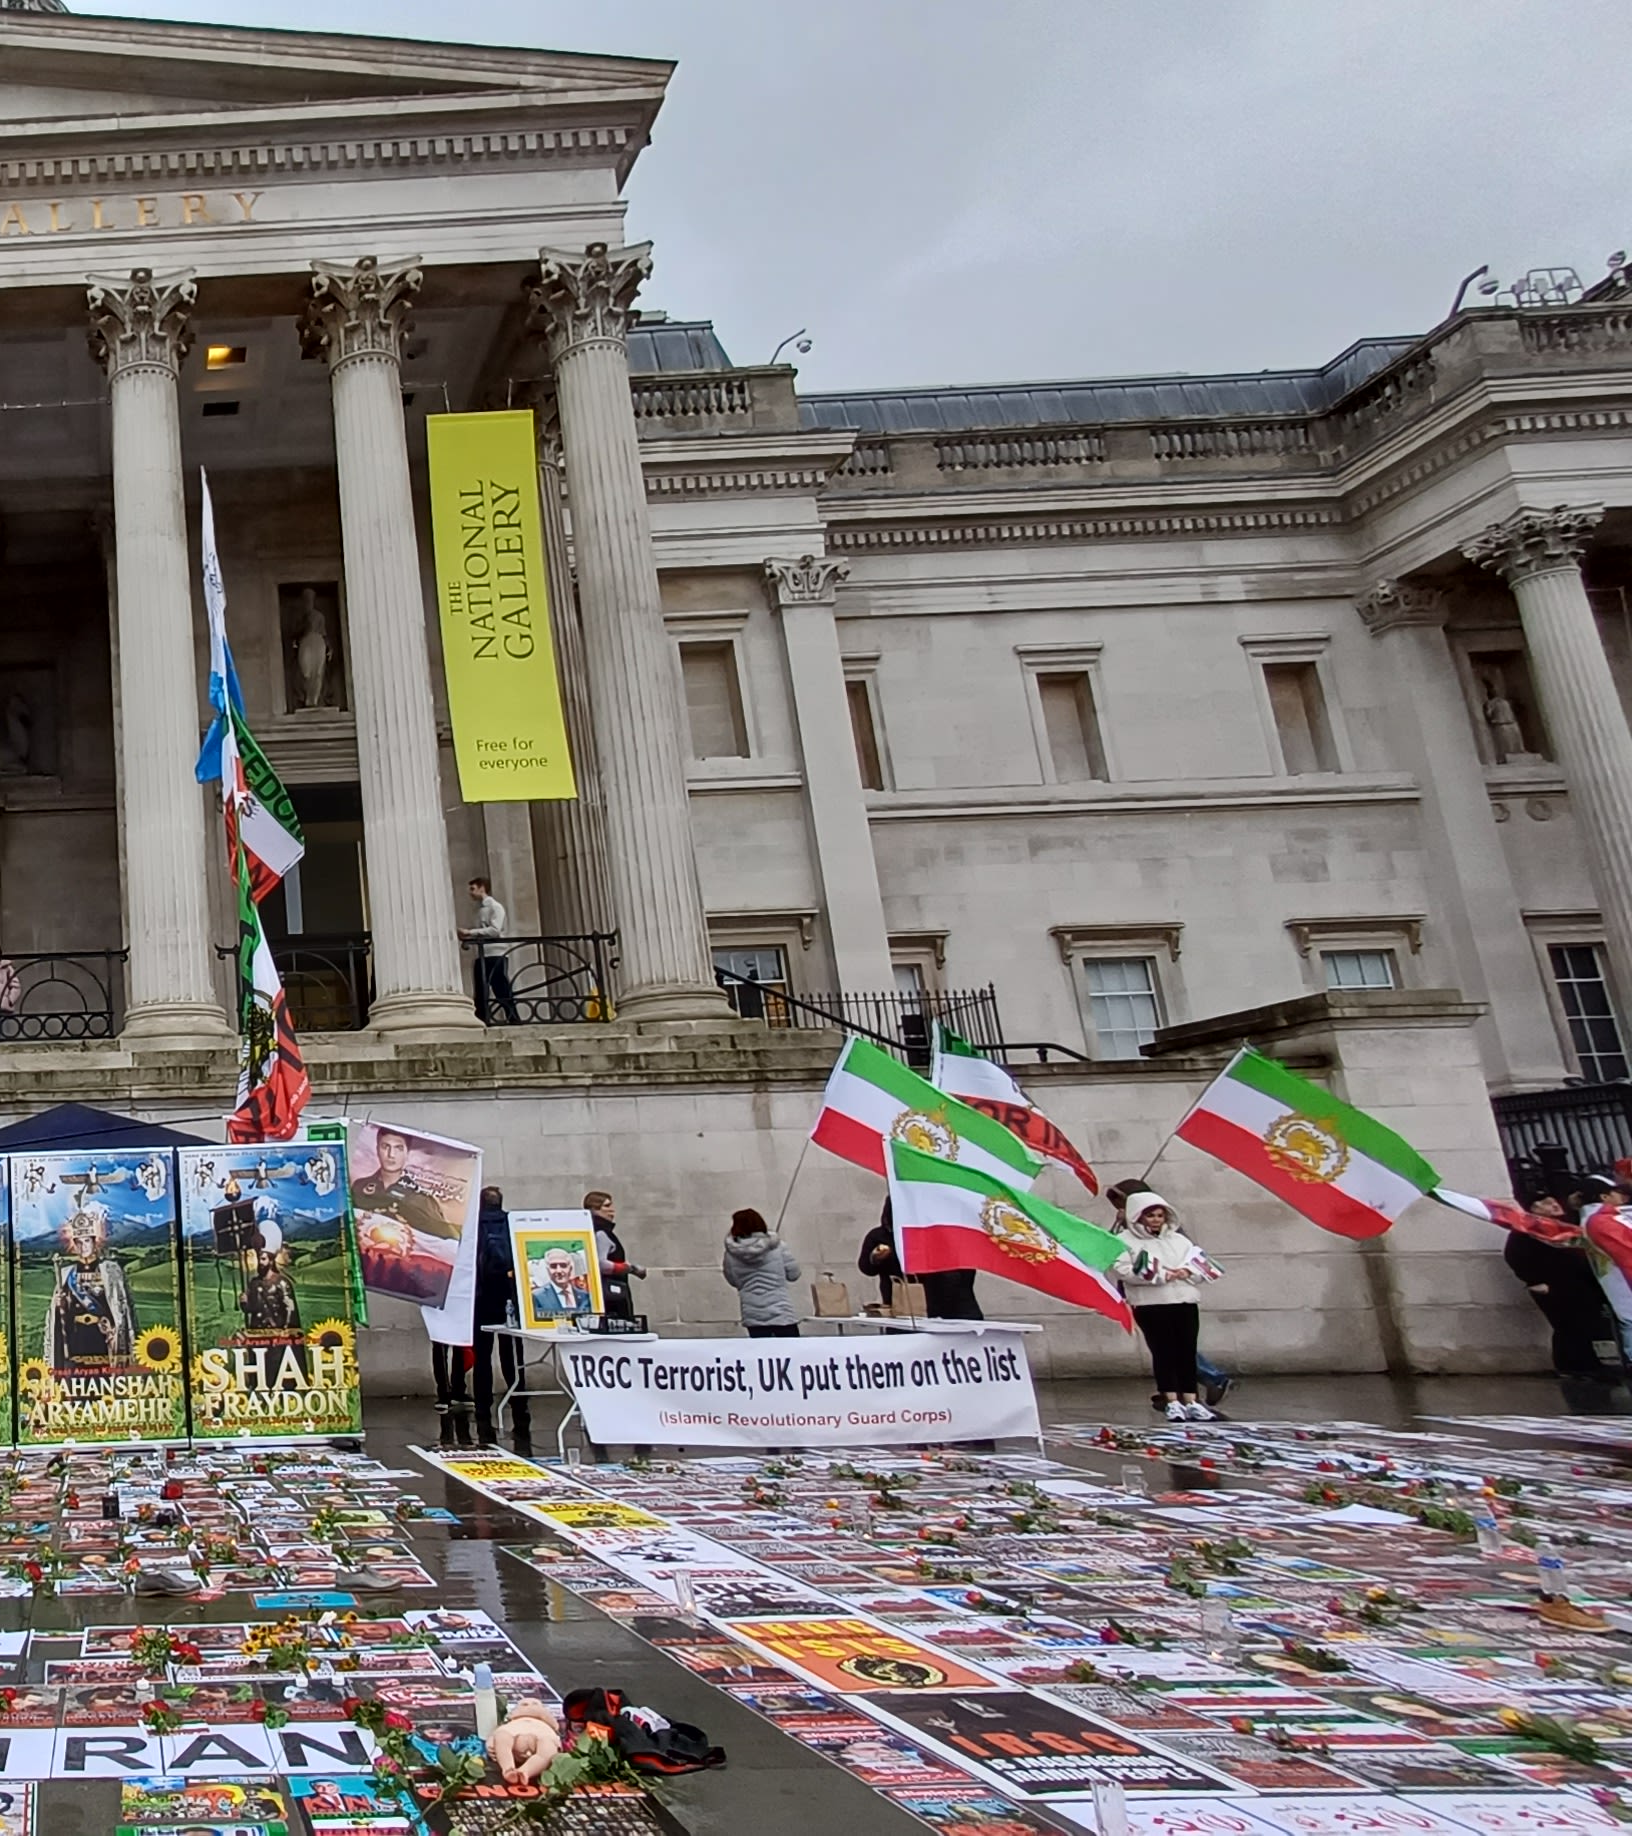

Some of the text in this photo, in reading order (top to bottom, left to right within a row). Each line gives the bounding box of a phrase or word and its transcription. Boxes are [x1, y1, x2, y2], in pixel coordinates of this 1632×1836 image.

[460, 480, 498, 660] NATIONAL
[491, 481, 534, 660] GALLERY
[450, 580, 463, 616] THE
[476, 736, 534, 752] Free for
[479, 756, 549, 770] everyone
[202, 1345, 348, 1392] SHAH
[569, 1346, 1022, 1400] IRGC Terrorist, UK put them on the list
[28, 1374, 174, 1400] SHAHANSHAH
[30, 1398, 176, 1426] ARYAMEHR
[204, 1389, 350, 1419] FRAYDON
[659, 1408, 953, 1429] (Islamic Revolutionary Guard Corps)
[733, 1619, 877, 1638] IRGC
[768, 1637, 921, 1658] ISIS
[949, 1730, 1142, 1758] IRGC
